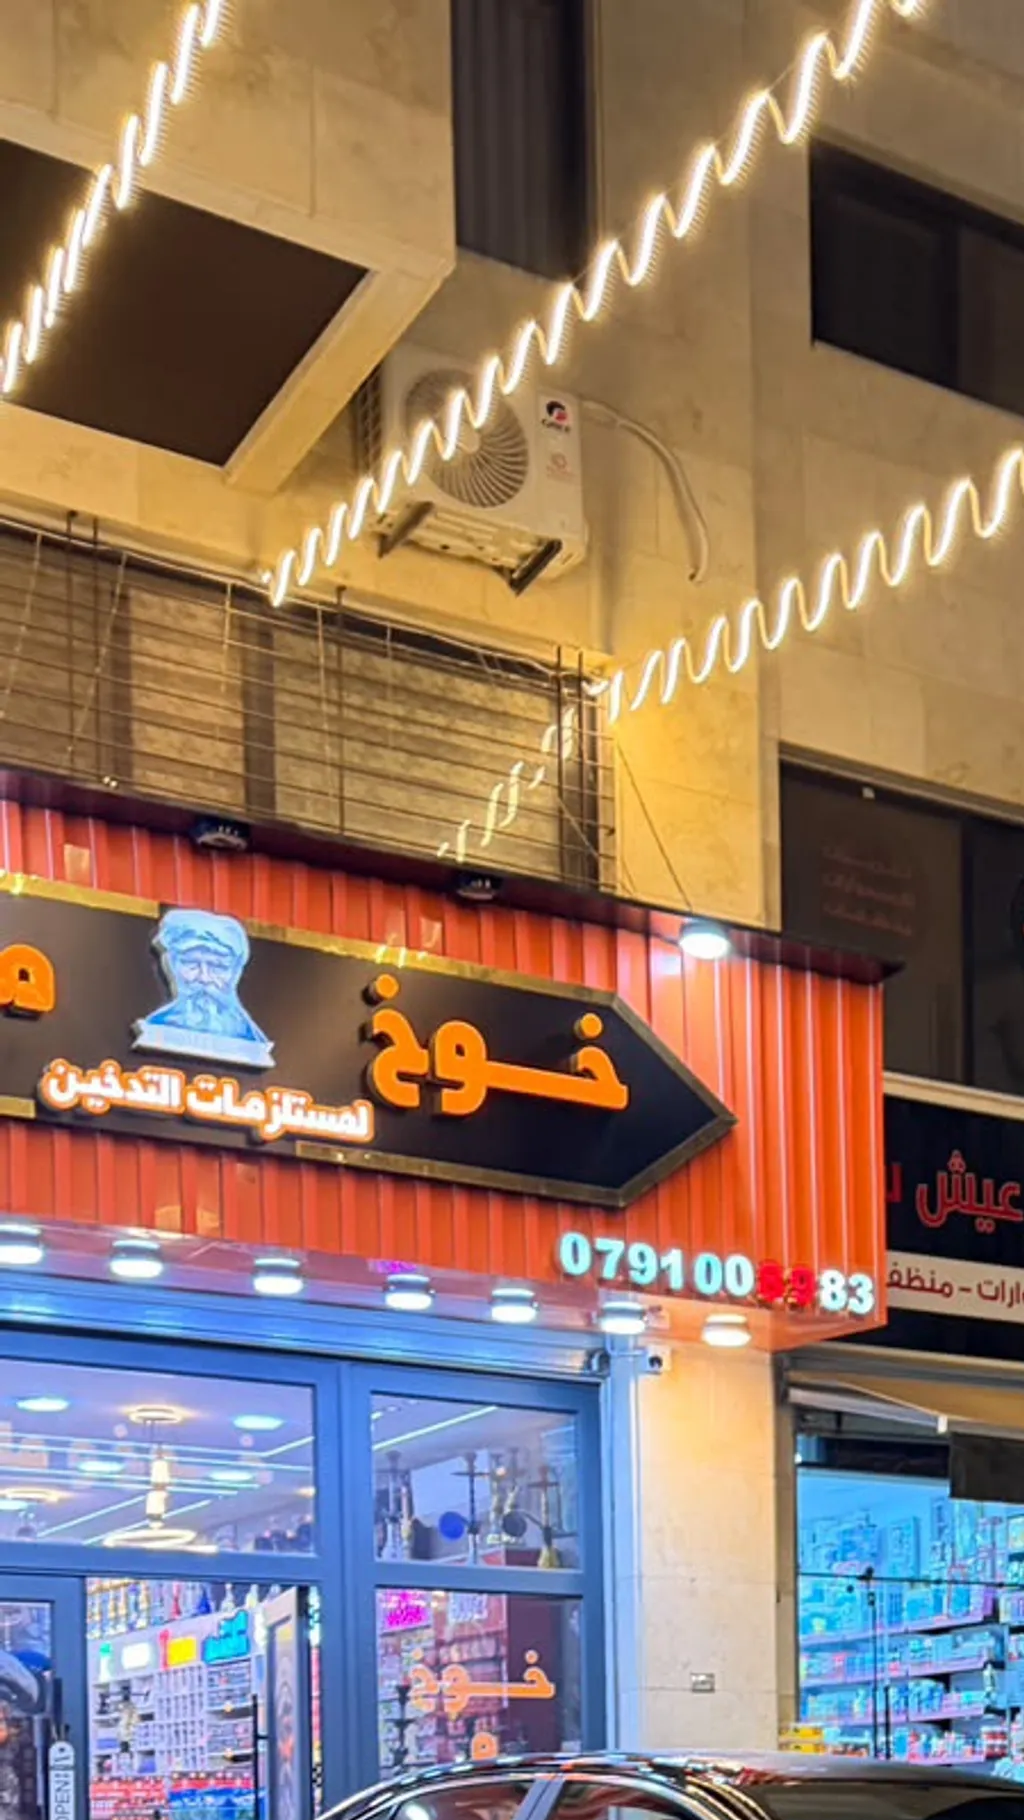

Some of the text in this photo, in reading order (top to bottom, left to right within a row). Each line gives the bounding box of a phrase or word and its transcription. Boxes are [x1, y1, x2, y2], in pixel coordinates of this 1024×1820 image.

[372, 973, 629, 1116] خوخ
[43, 1059, 373, 1142] لمستلزمات التدخين
[915, 1150, 1024, 1234] عيش
